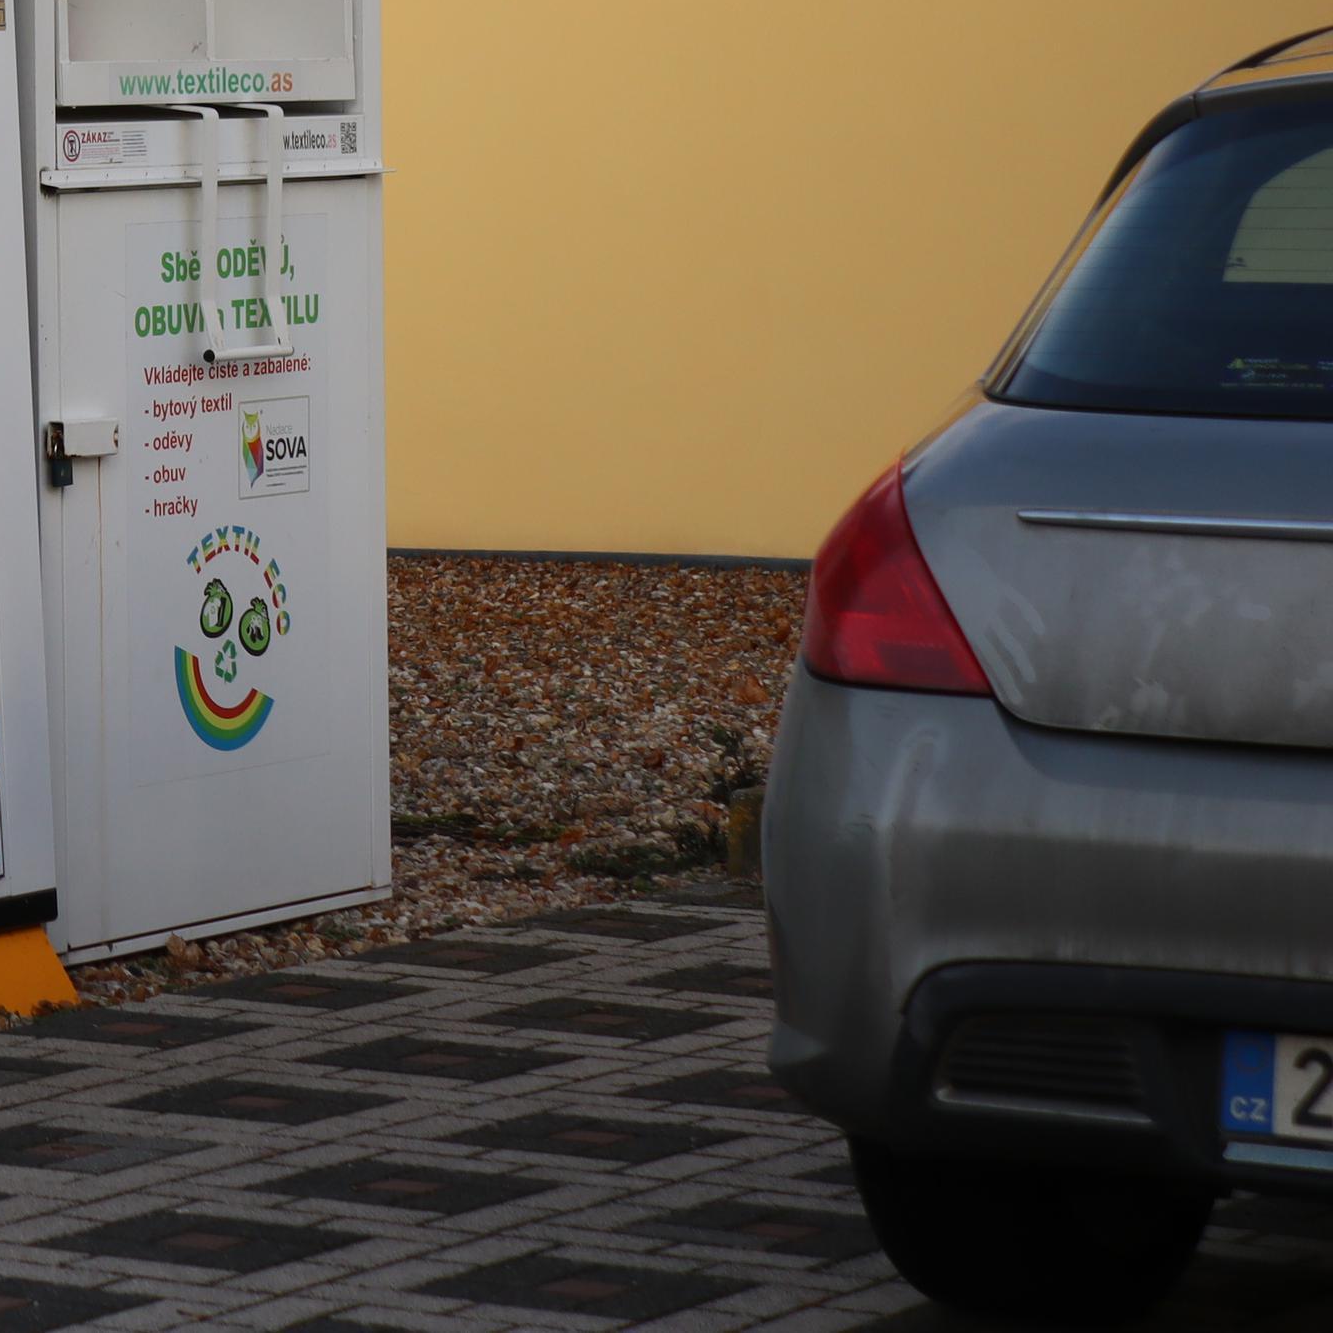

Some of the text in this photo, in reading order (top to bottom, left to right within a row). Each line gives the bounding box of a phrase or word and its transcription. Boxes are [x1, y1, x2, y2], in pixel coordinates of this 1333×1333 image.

[120, 67, 293, 95] www.textileco.as
[81, 130, 107, 144] ZÁKAZ
[283, 129, 337, 150] w.textileco.as
[161, 250, 201, 283] Sbě
[231, 294, 319, 330] TEXILU
[144, 353, 311, 386] Vkládejte čisté a zabalené:
[153, 393, 232, 421] bytový textil
[153, 430, 193, 452] oděvy
[265, 436, 307, 461] SOVA
[153, 465, 186, 484] obuv
[154, 496, 198, 518] hračky
[186, 525, 290, 636] TEXTIL ECO
[1230, 1096, 1268, 1122] CZ
